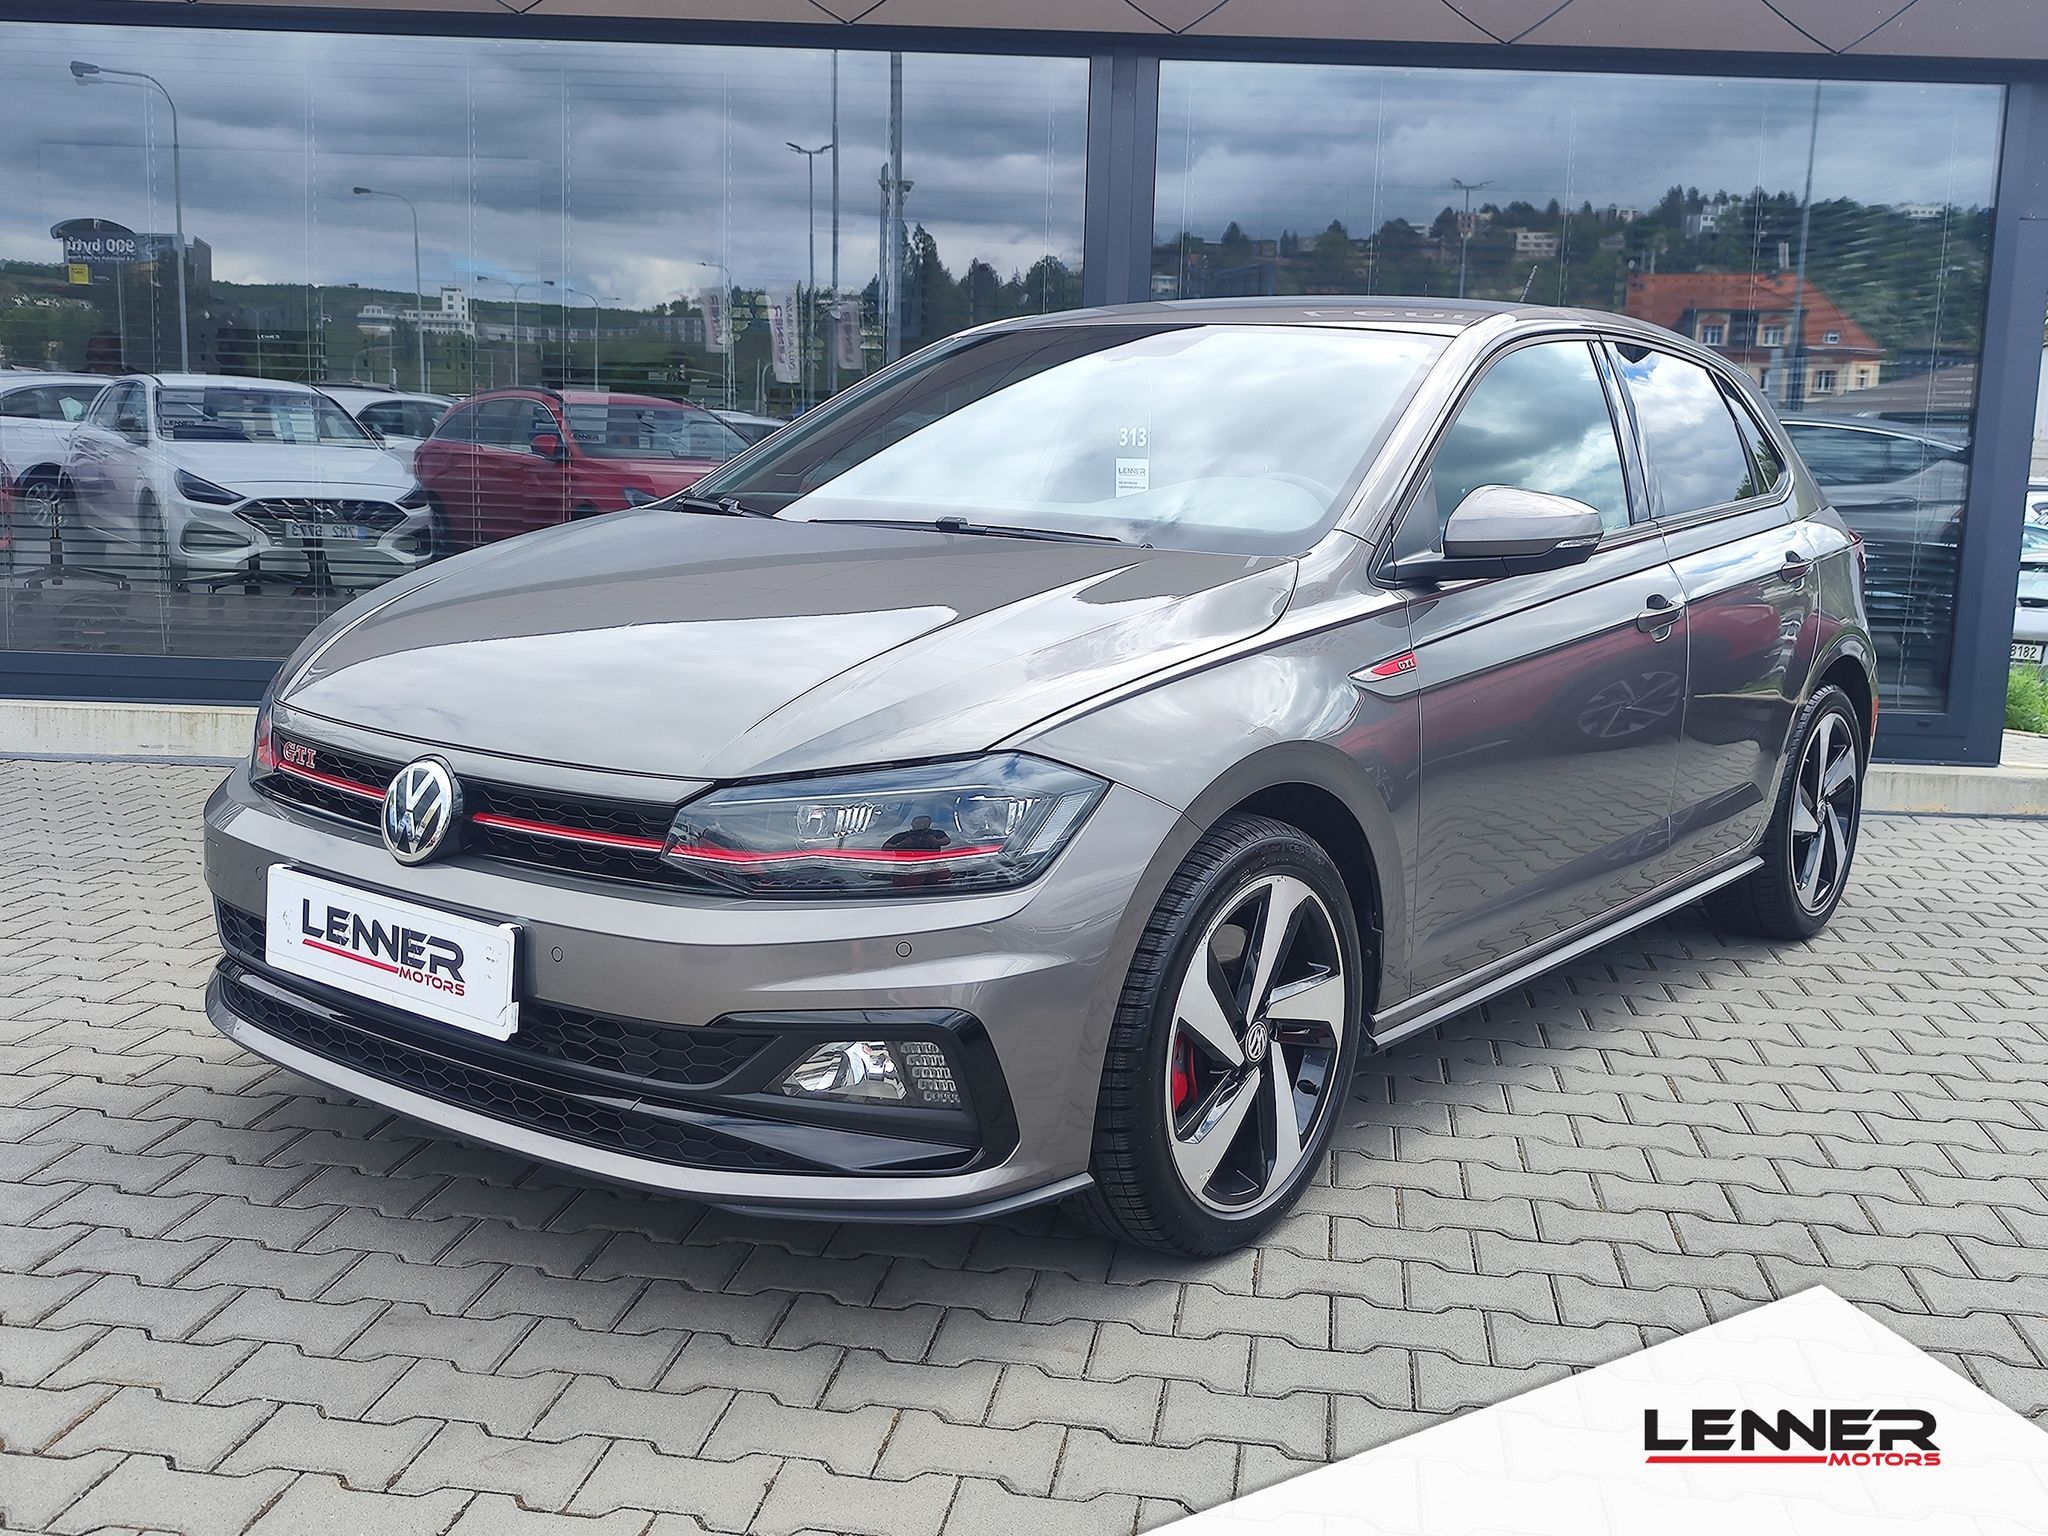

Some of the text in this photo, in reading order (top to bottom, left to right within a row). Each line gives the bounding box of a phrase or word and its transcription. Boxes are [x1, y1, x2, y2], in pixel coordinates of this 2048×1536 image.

[1118, 427, 1148, 447] 313
[1118, 467, 1147, 477] LENNER
[1398, 659, 1415, 670] GTI
[283, 741, 317, 768] GTI
[302, 898, 466, 983] LENNER
[399, 967, 466, 997] MOTORS
